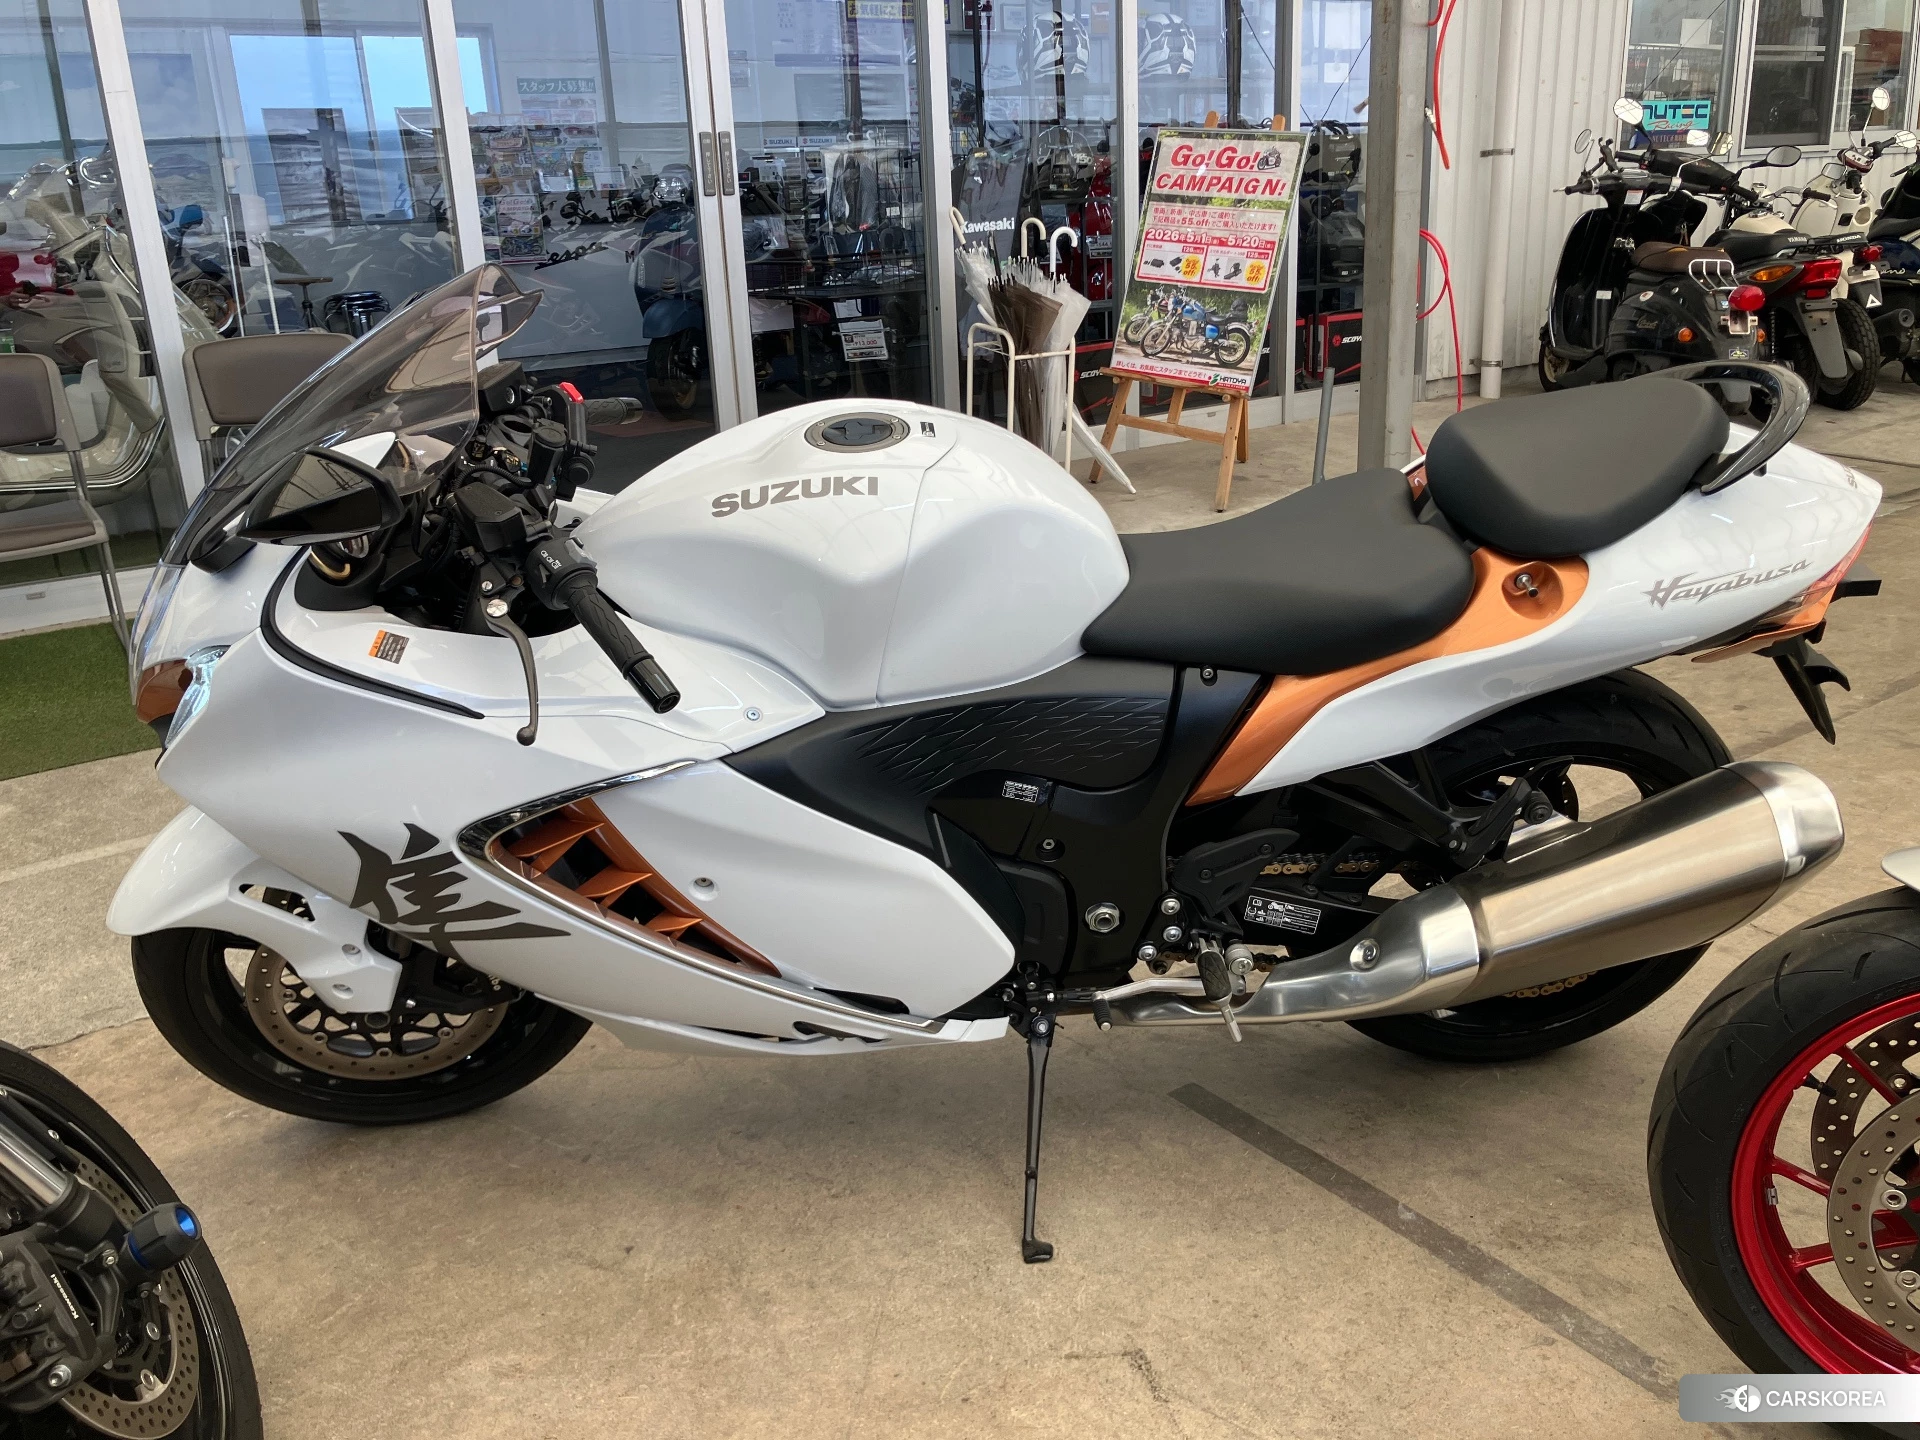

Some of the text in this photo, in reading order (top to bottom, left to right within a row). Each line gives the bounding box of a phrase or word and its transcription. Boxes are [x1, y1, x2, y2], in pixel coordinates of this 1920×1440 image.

[1156, 173, 1286, 196] CAMPAIGN!
[963, 217, 1015, 233] Kawasaki
[1836, 234, 1862, 243] HONDA
[1220, 375, 1246, 385] HATOYA
[711, 476, 879, 518] SUZUKI
[1642, 559, 1814, 611] Hayabusa
[50, 1273, 79, 1320] Kawasaki
